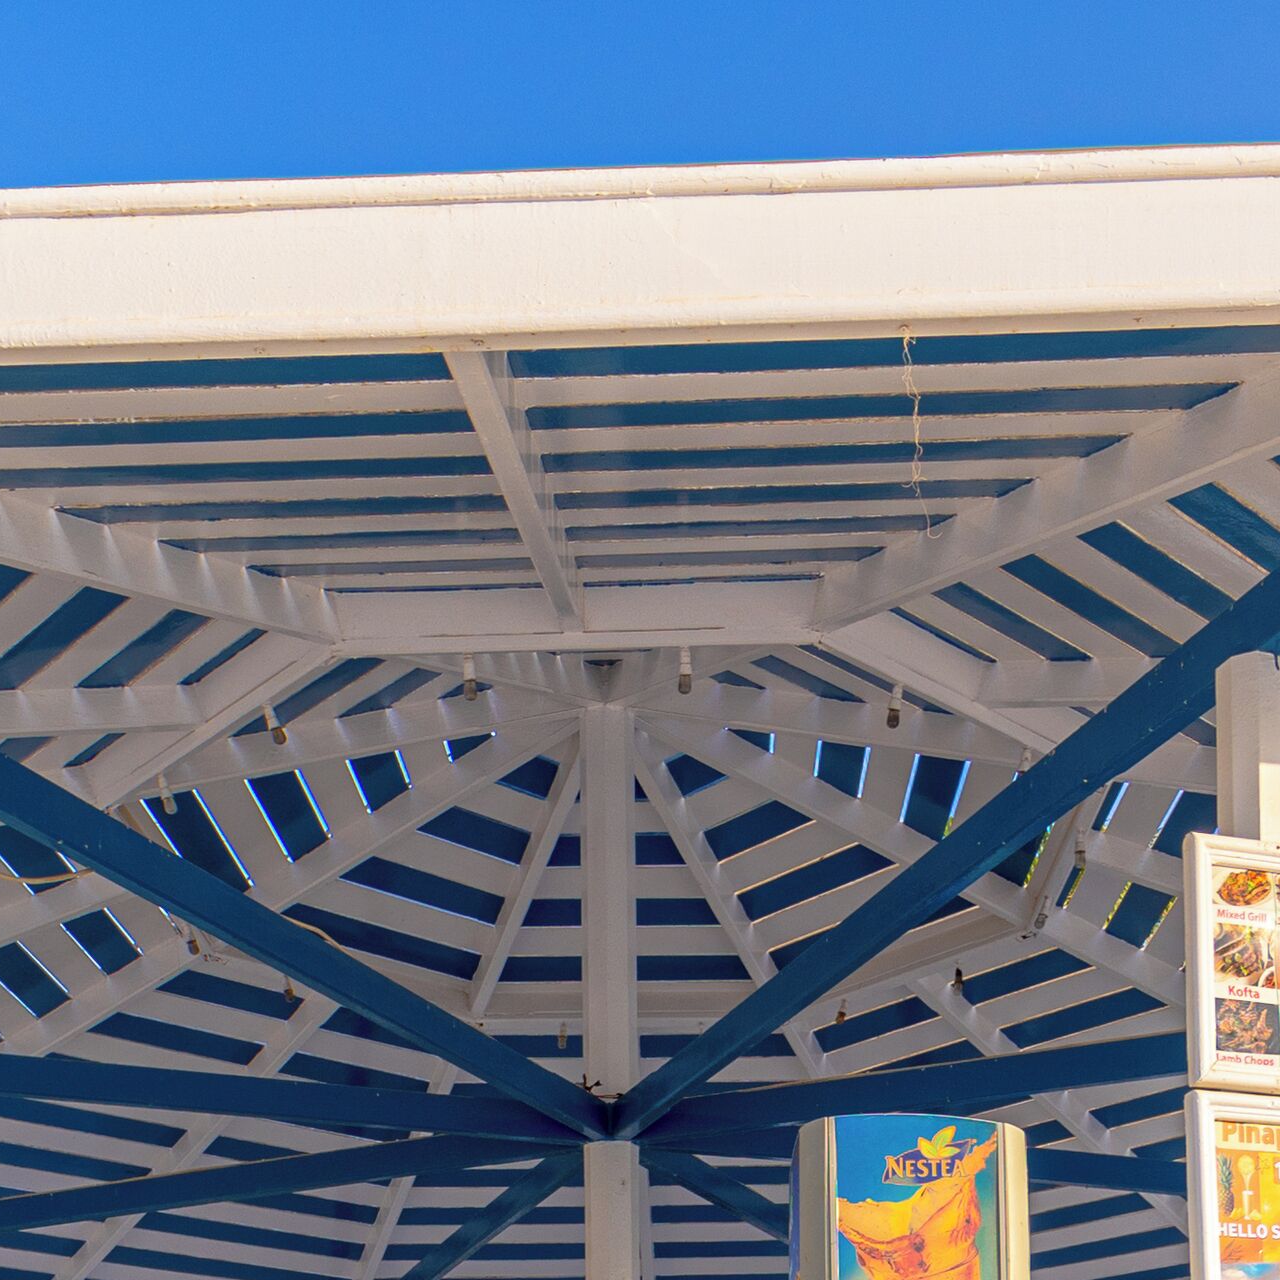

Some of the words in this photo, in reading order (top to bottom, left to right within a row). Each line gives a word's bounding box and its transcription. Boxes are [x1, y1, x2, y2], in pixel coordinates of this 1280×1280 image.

[1216, 909, 1246, 921] Mixed
[1247, 912, 1267, 923] Grill
[1227, 985, 1260, 999] Kofta
[1216, 1053, 1242, 1064] Lamb
[886, 1156, 967, 1178] NESTEA
[1218, 1222, 1268, 1239] HELLO
